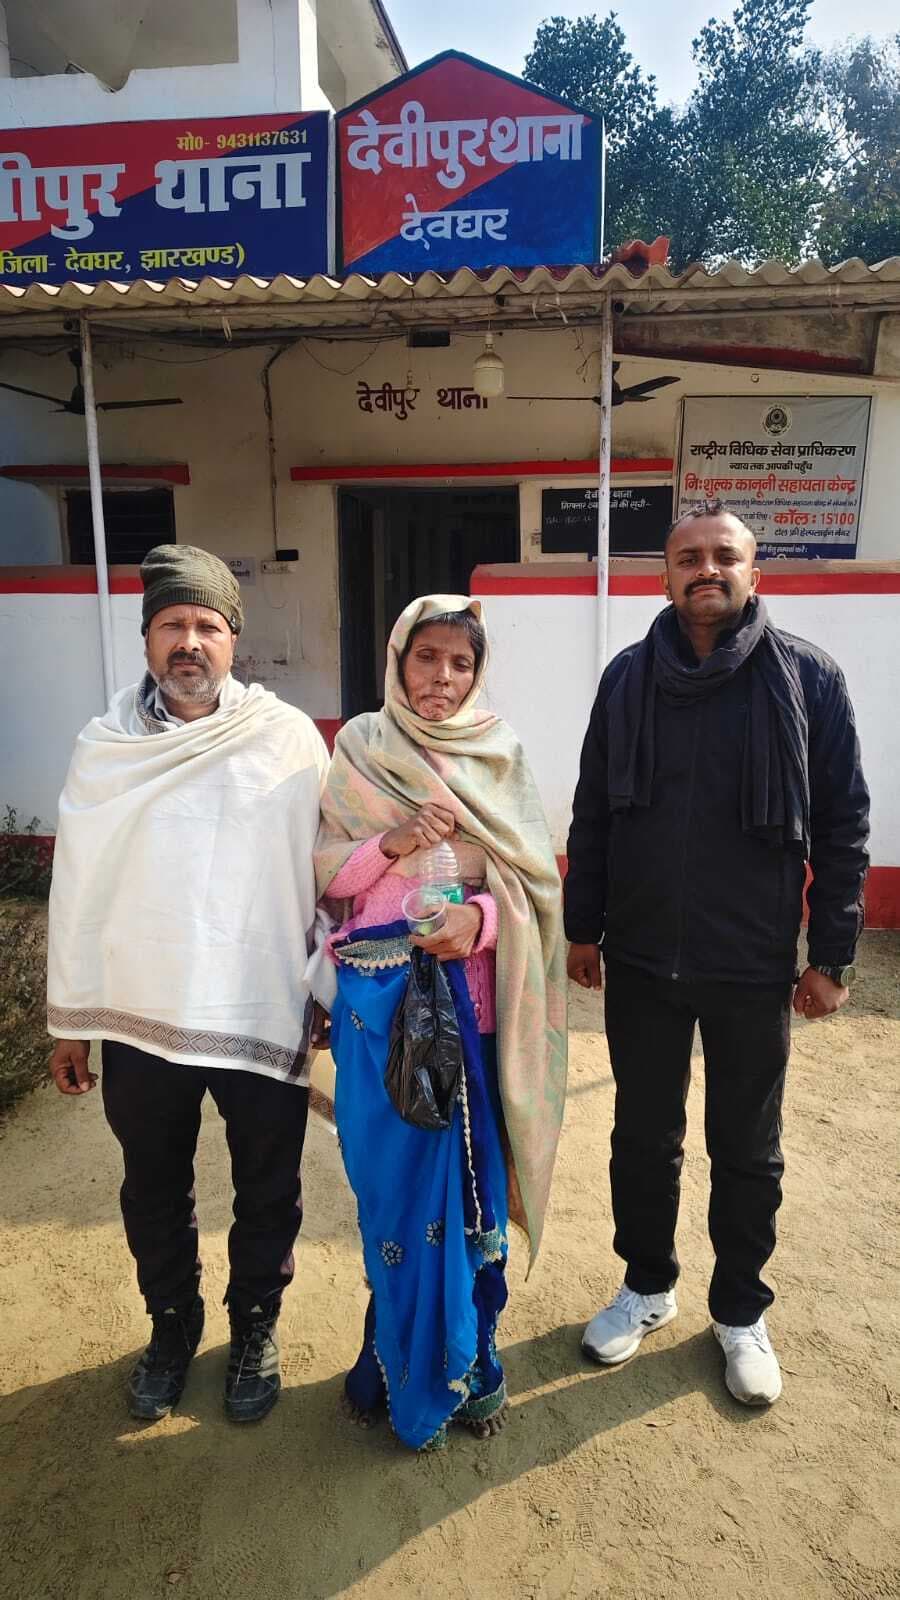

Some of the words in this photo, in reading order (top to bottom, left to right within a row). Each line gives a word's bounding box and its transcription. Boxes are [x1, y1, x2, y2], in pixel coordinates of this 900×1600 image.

[216, 128, 308, 150] 9431137631
[0, 152, 125, 240] ीपुर
[154, 151, 312, 214] थाना
[400, 193, 509, 250] देवघर
[356, 381, 420, 420] देवीपुर
[690, 440, 727, 460] राष्ट्रीय
[729, 440, 768, 457] विधिक
[770, 441, 795, 457] सेवा
[797, 440, 857, 458] प्राधिकरण
[729, 462, 748, 471] न्याय
[749, 462, 765, 471] तक
[765, 460, 793, 471] आपकी
[735, 473, 777, 498] कानूनी
[778, 478, 826, 494] सहायता
[827, 475, 857, 495] केन्द्र
[821, 512, 855, 526] 15100
